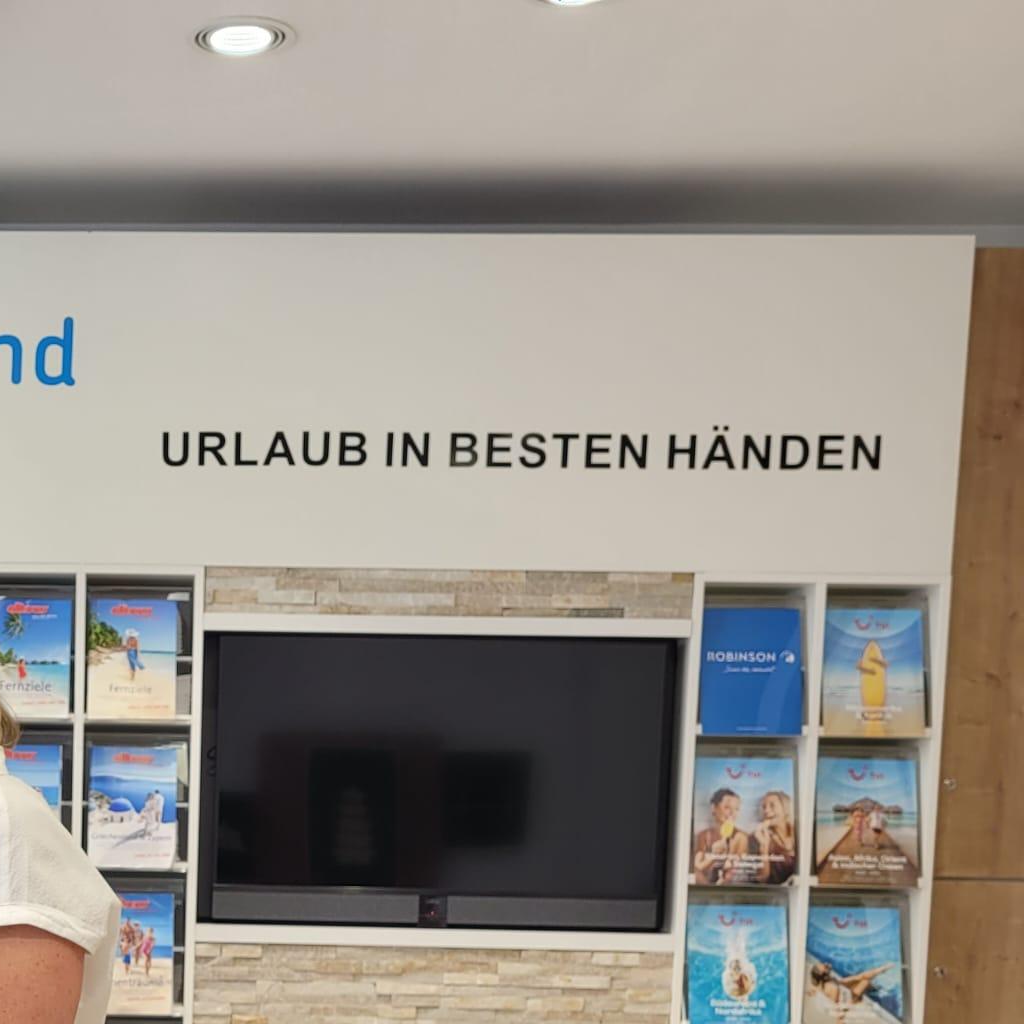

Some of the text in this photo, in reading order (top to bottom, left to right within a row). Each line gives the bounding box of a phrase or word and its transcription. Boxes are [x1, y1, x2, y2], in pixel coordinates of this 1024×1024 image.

[162, 425, 882, 470] URLAUB IN BESTEN HÄNDEN
[706, 650, 776, 662] ROBINSON
